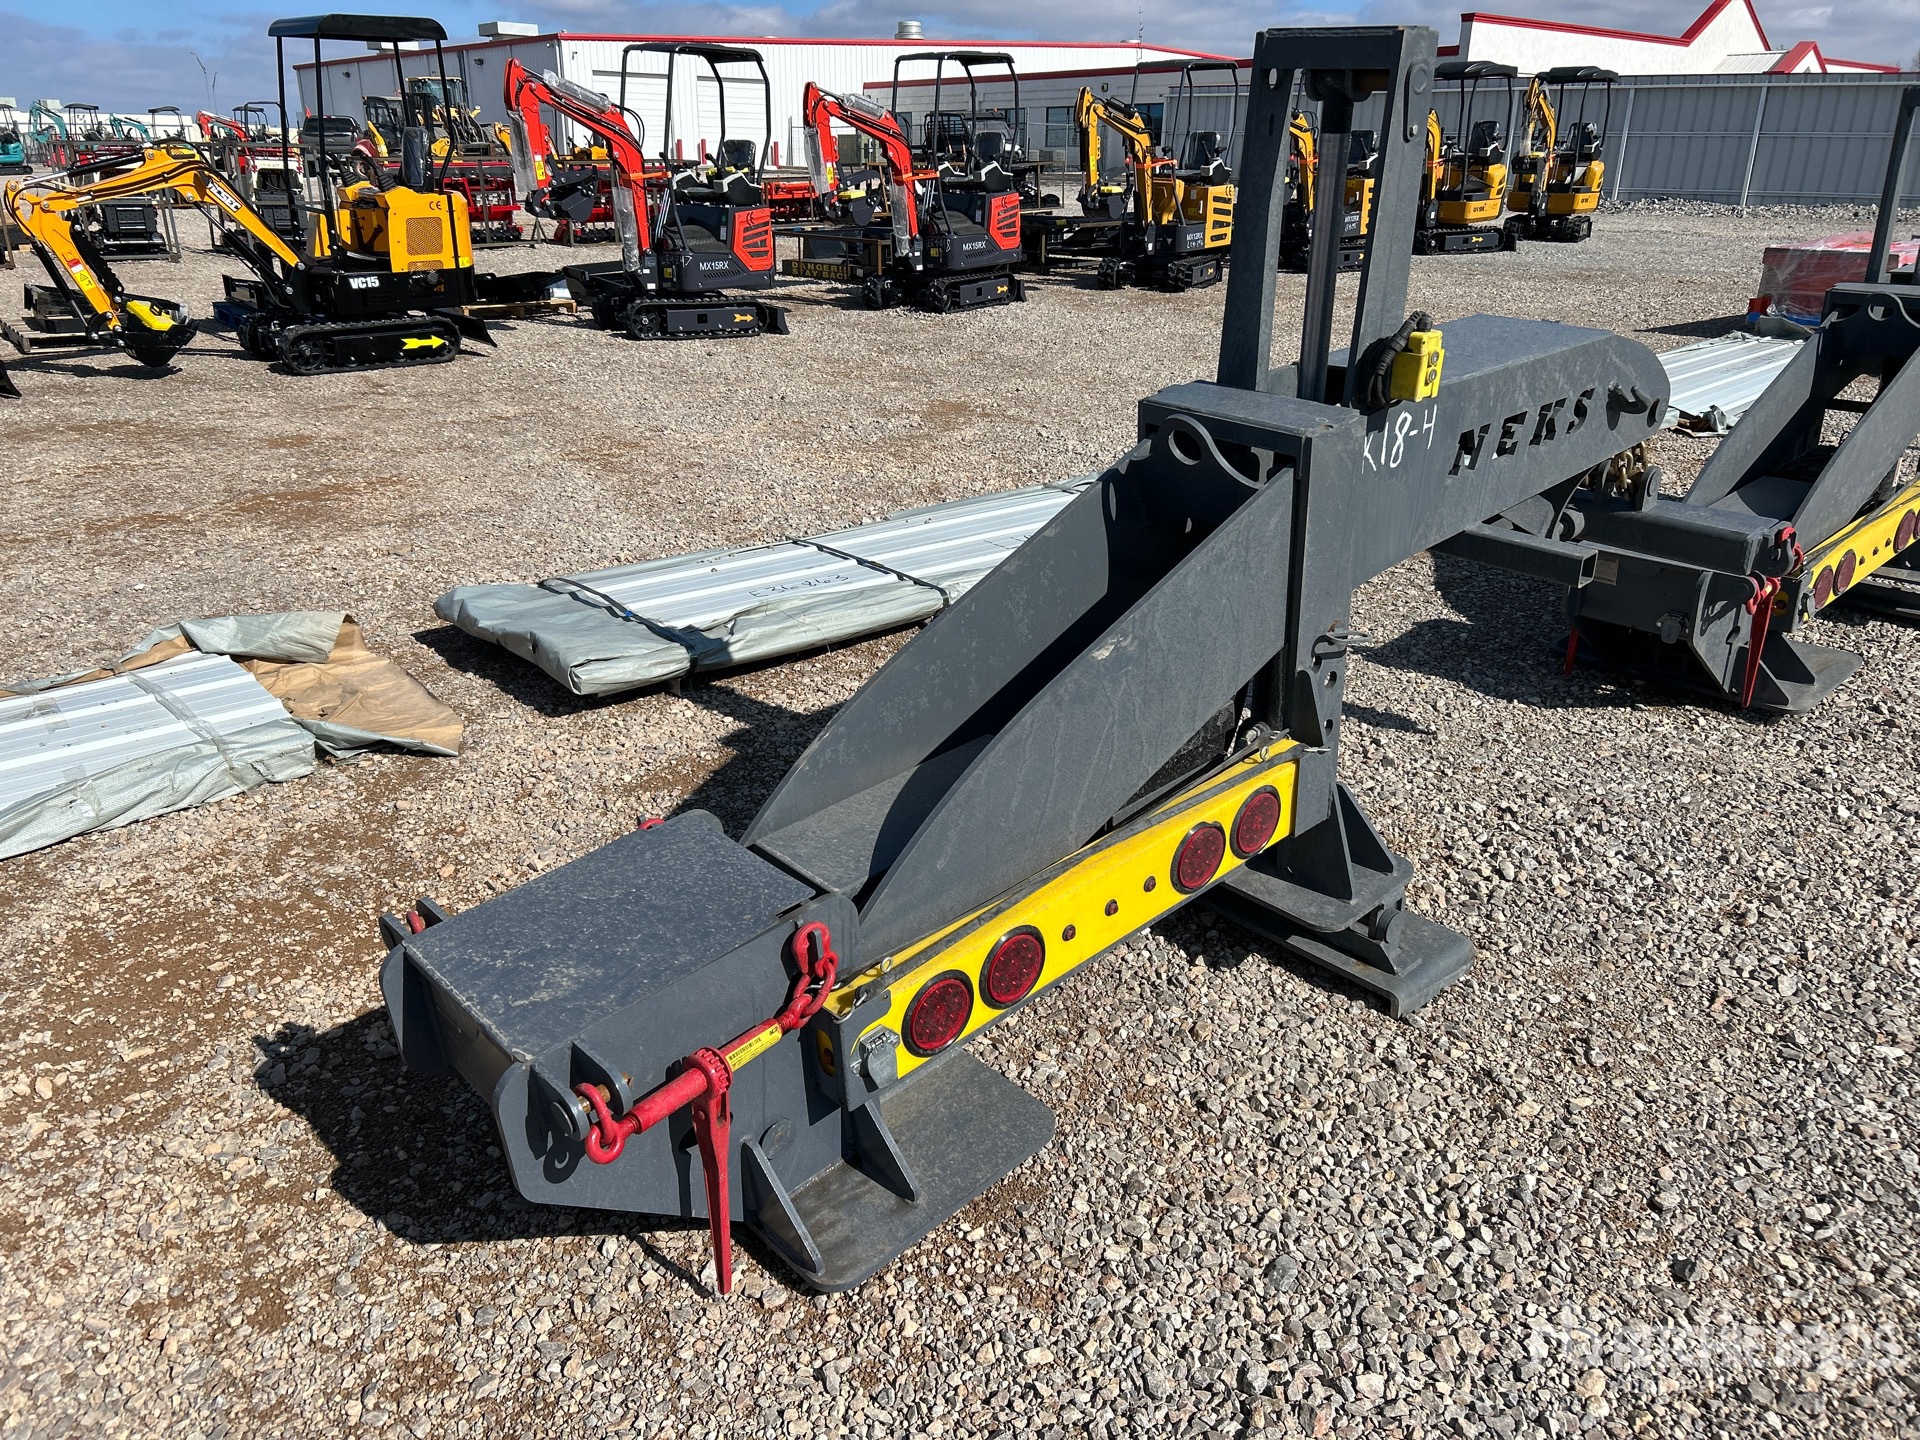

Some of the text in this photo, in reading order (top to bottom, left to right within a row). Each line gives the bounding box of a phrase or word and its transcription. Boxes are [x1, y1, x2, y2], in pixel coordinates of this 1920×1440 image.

[962, 240, 987, 251] MX15RX
[699, 261, 730, 271] MX15RX
[791, 268, 819, 278] STAY
[350, 276, 380, 289] VC15
[1448, 388, 1596, 476] NEKS
